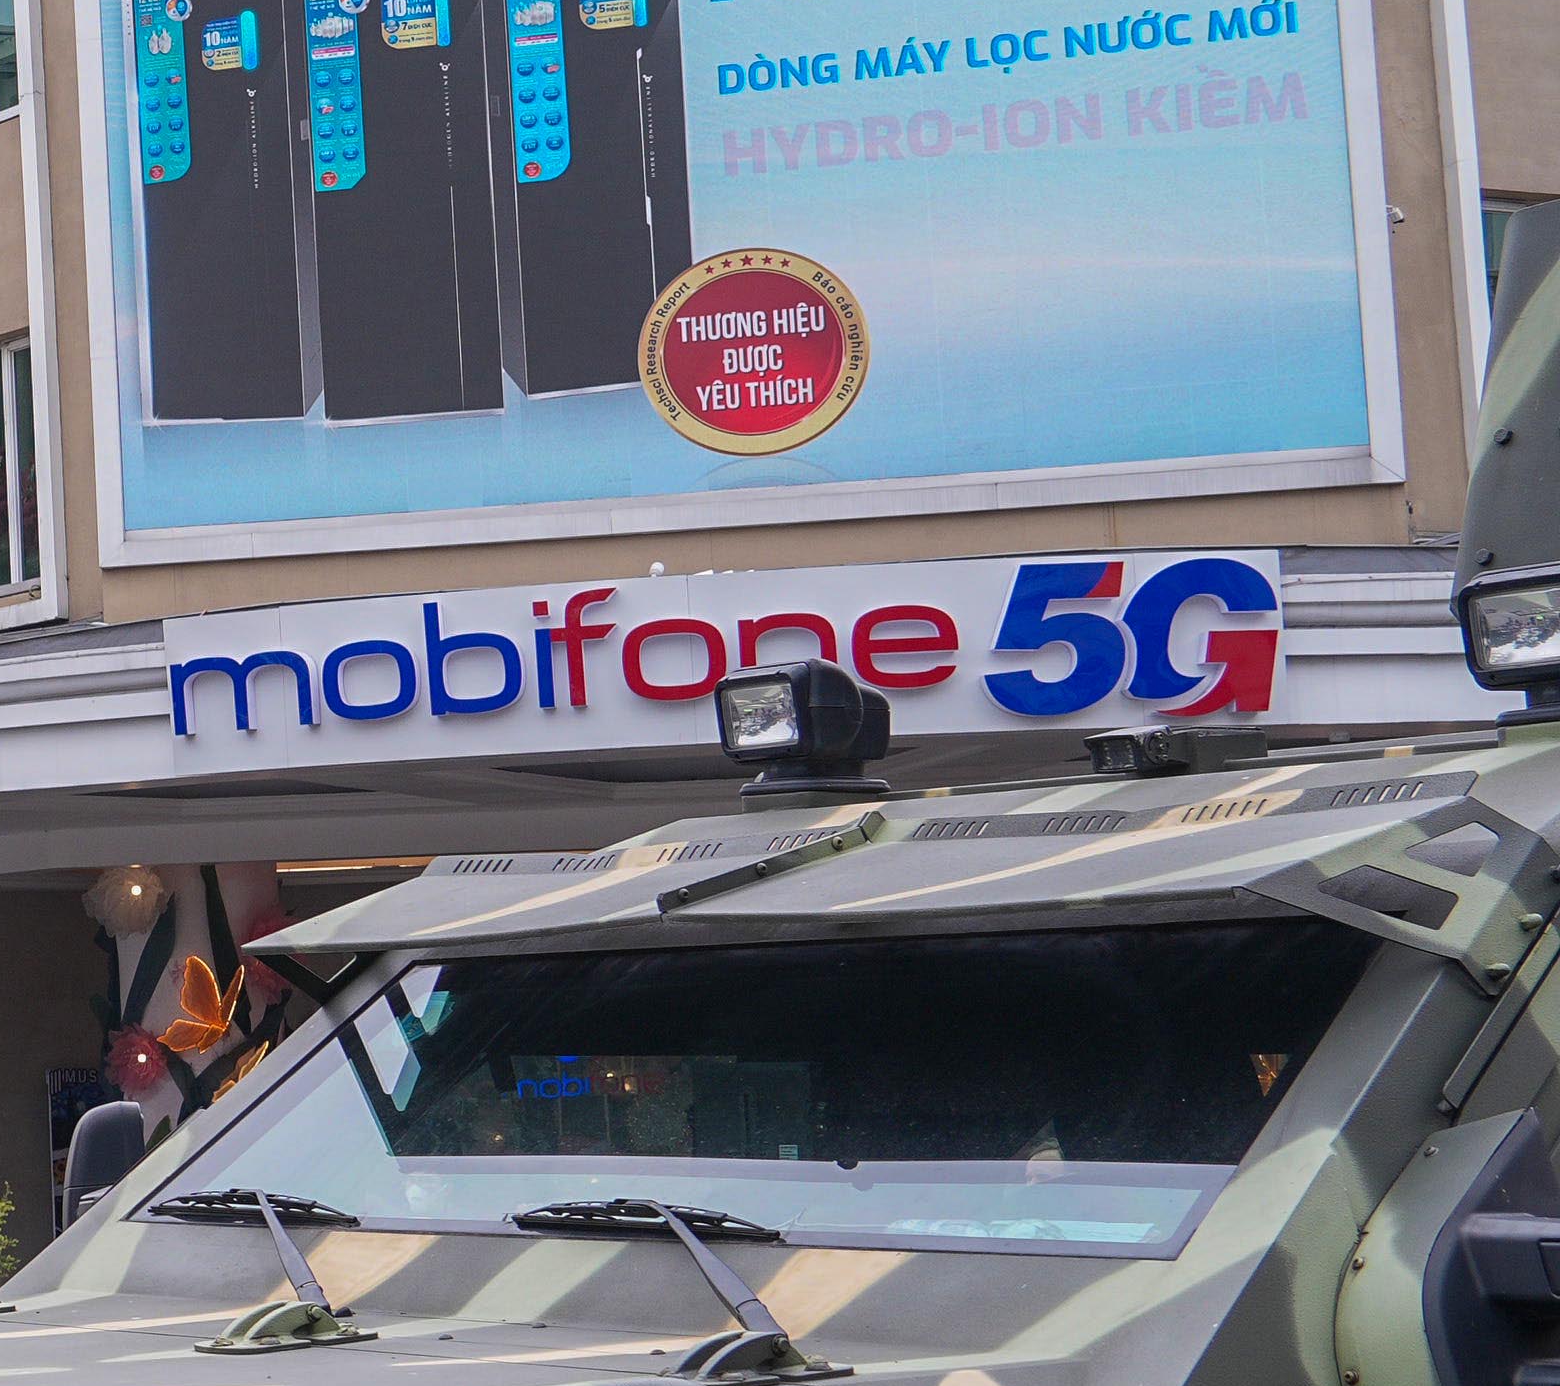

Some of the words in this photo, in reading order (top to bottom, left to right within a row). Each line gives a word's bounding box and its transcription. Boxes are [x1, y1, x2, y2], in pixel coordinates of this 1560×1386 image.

[402, 21, 408, 30] 7
[599, 4, 606, 13] 5
[203, 31, 220, 46] 10
[717, 51, 840, 96] DÒNG
[853, 35, 952, 82] MÁY
[965, 28, 1051, 74] LỌC
[1063, 9, 1193, 59] NƯỚC
[722, 92, 1104, 176] HYDRO-ION
[812, 271, 836, 295] Báo
[676, 310, 767, 343] THƯƠNG
[772, 301, 825, 338] HIỆU
[836, 296, 854, 319] cáo
[646, 319, 663, 376] Research
[656, 281, 691, 317] Report
[722, 343, 784, 377] ĐƯỢC
[847, 323, 864, 371] nghiên
[696, 378, 741, 412] YÊU
[745, 374, 814, 408] THÍCH
[836, 376, 856, 402] cứu
[170, 586, 960, 738] mobifone
[983, 558, 1282, 721] 5G
